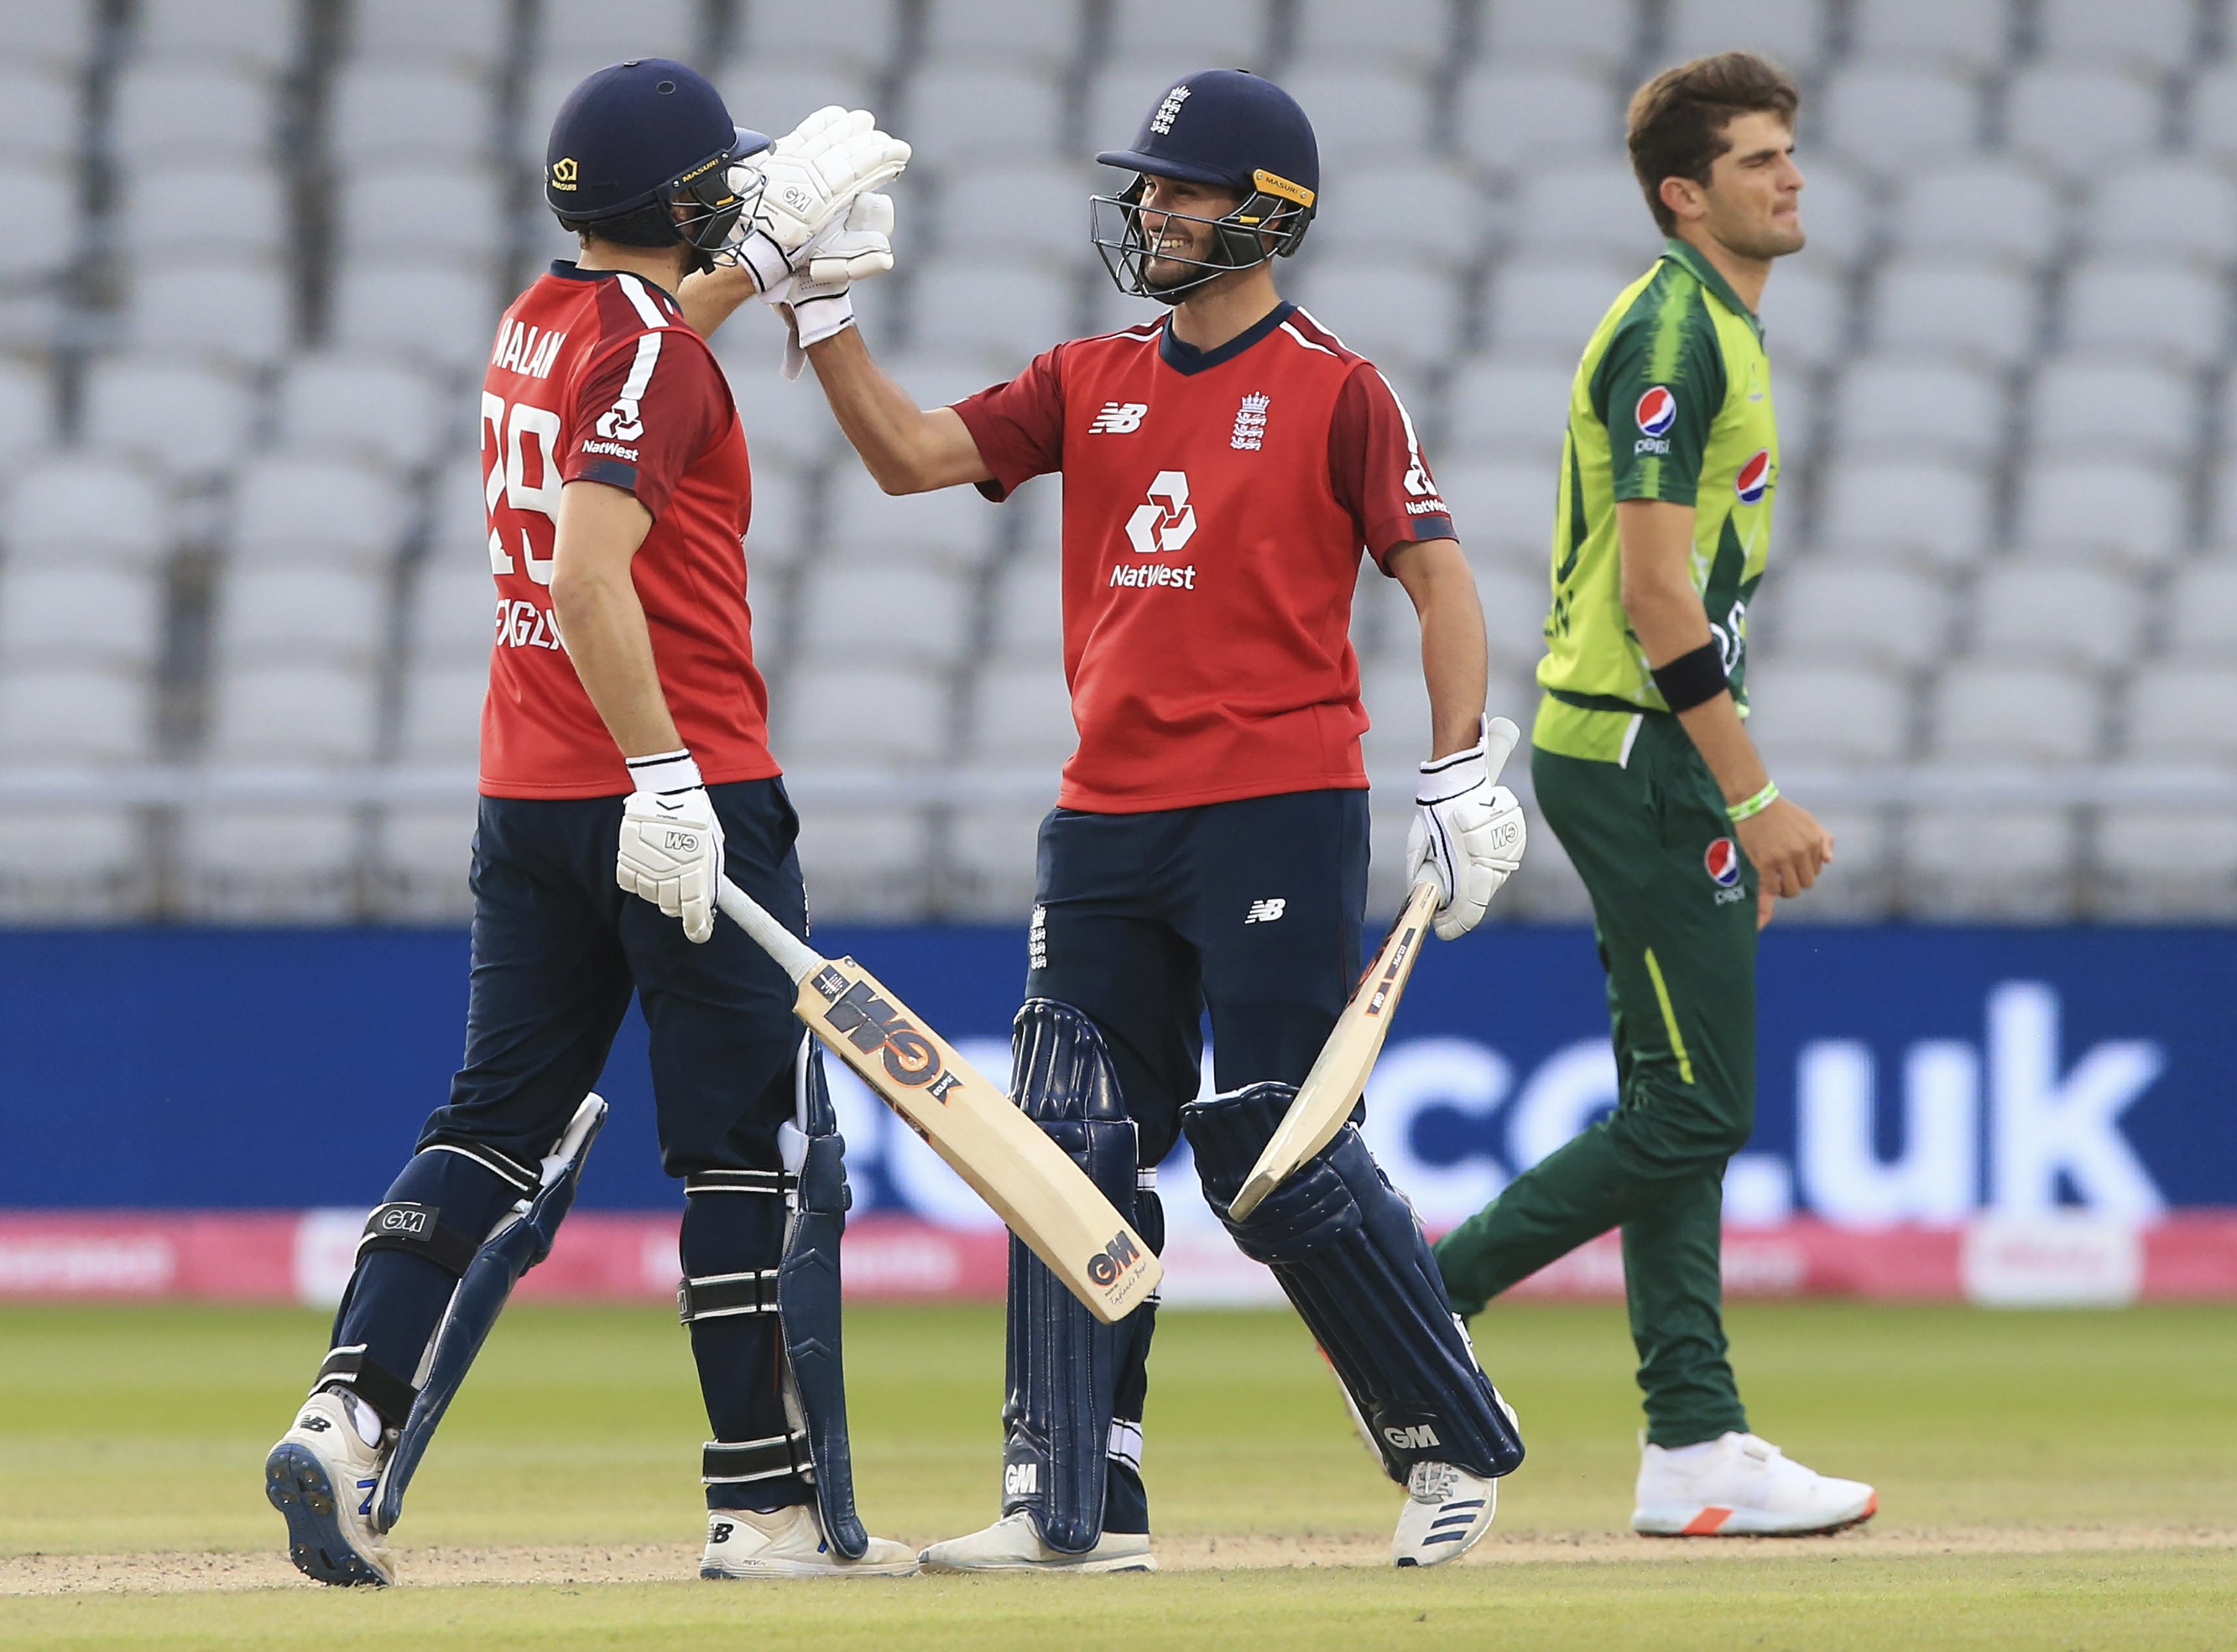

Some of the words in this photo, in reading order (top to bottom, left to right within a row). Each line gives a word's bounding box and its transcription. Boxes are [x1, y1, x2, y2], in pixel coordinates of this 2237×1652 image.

[682, 158, 720, 183] MASURI
[551, 179, 577, 192] MASURI
[1265, 177, 1298, 194] MASURI
[782, 186, 813, 212] GM
[491, 316, 567, 379] MALAN
[581, 439, 640, 462] NatWest
[480, 390, 563, 586] 29
[1109, 563, 1196, 590] NatWest
[664, 830, 699, 853] GM
[1491, 821, 1520, 851] GM
[1371, 991, 1385, 1009] GM
[823, 979, 942, 1088] GM
[382, 1209, 427, 1233] GM
[1087, 1229, 1140, 1286] GM
[1383, 1423, 1441, 1449] GM
[1004, 1463, 1037, 1495] GM
